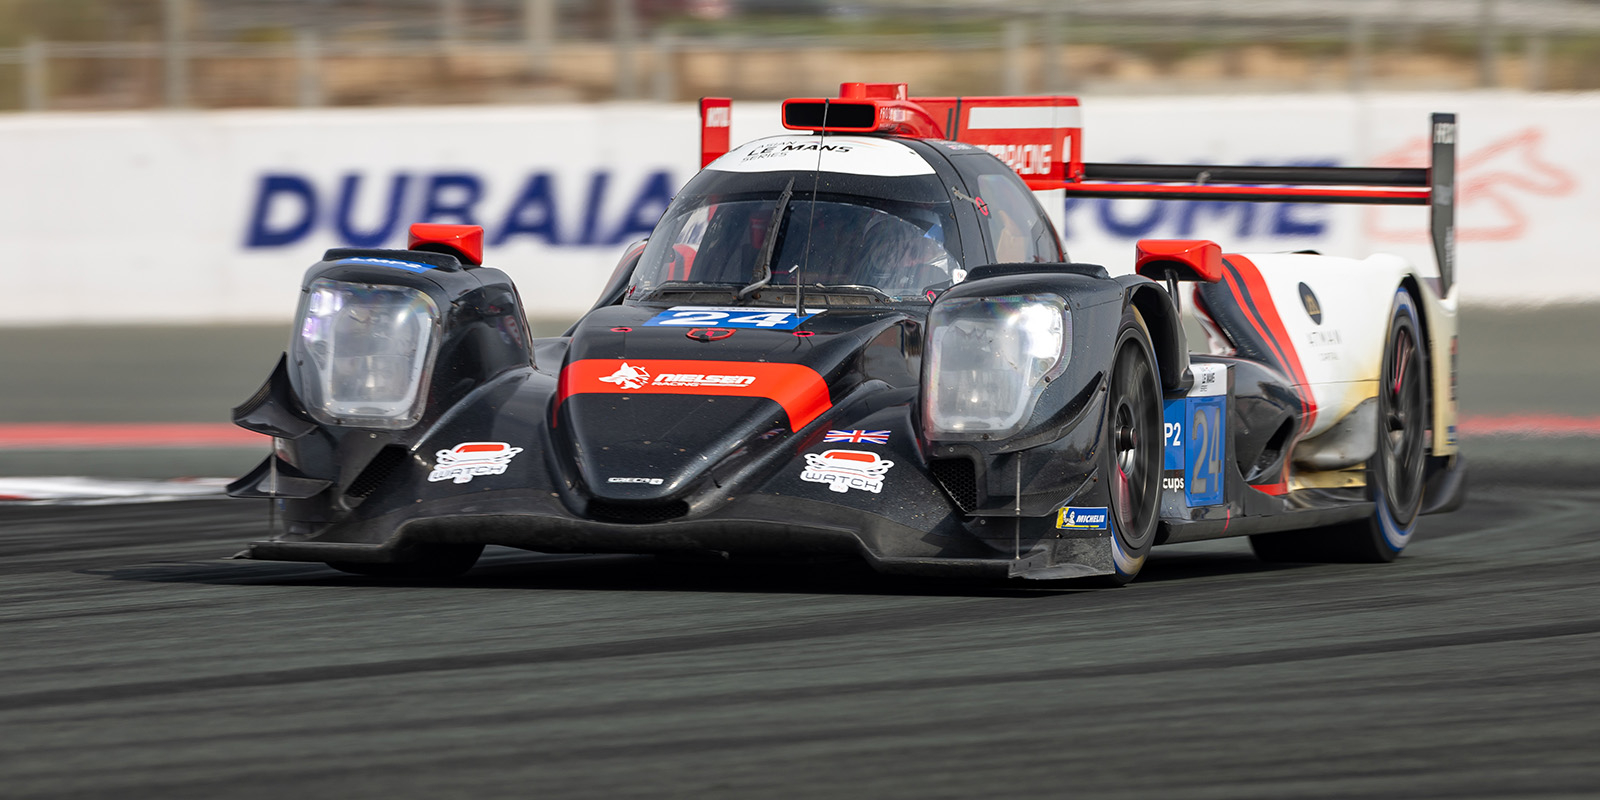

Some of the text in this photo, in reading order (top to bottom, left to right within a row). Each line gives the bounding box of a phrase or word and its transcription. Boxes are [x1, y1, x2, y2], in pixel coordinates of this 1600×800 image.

[781, 144, 854, 153] MANS
[659, 311, 791, 328] 24
[654, 373, 756, 385] NIELSEN
[1164, 422, 1181, 447] P2
[1190, 408, 1222, 494] 24
[432, 466, 504, 480] WATCH
[805, 472, 879, 490] WATCH
[1163, 477, 1185, 493] cups
[1076, 514, 1105, 523] MICHELIN
